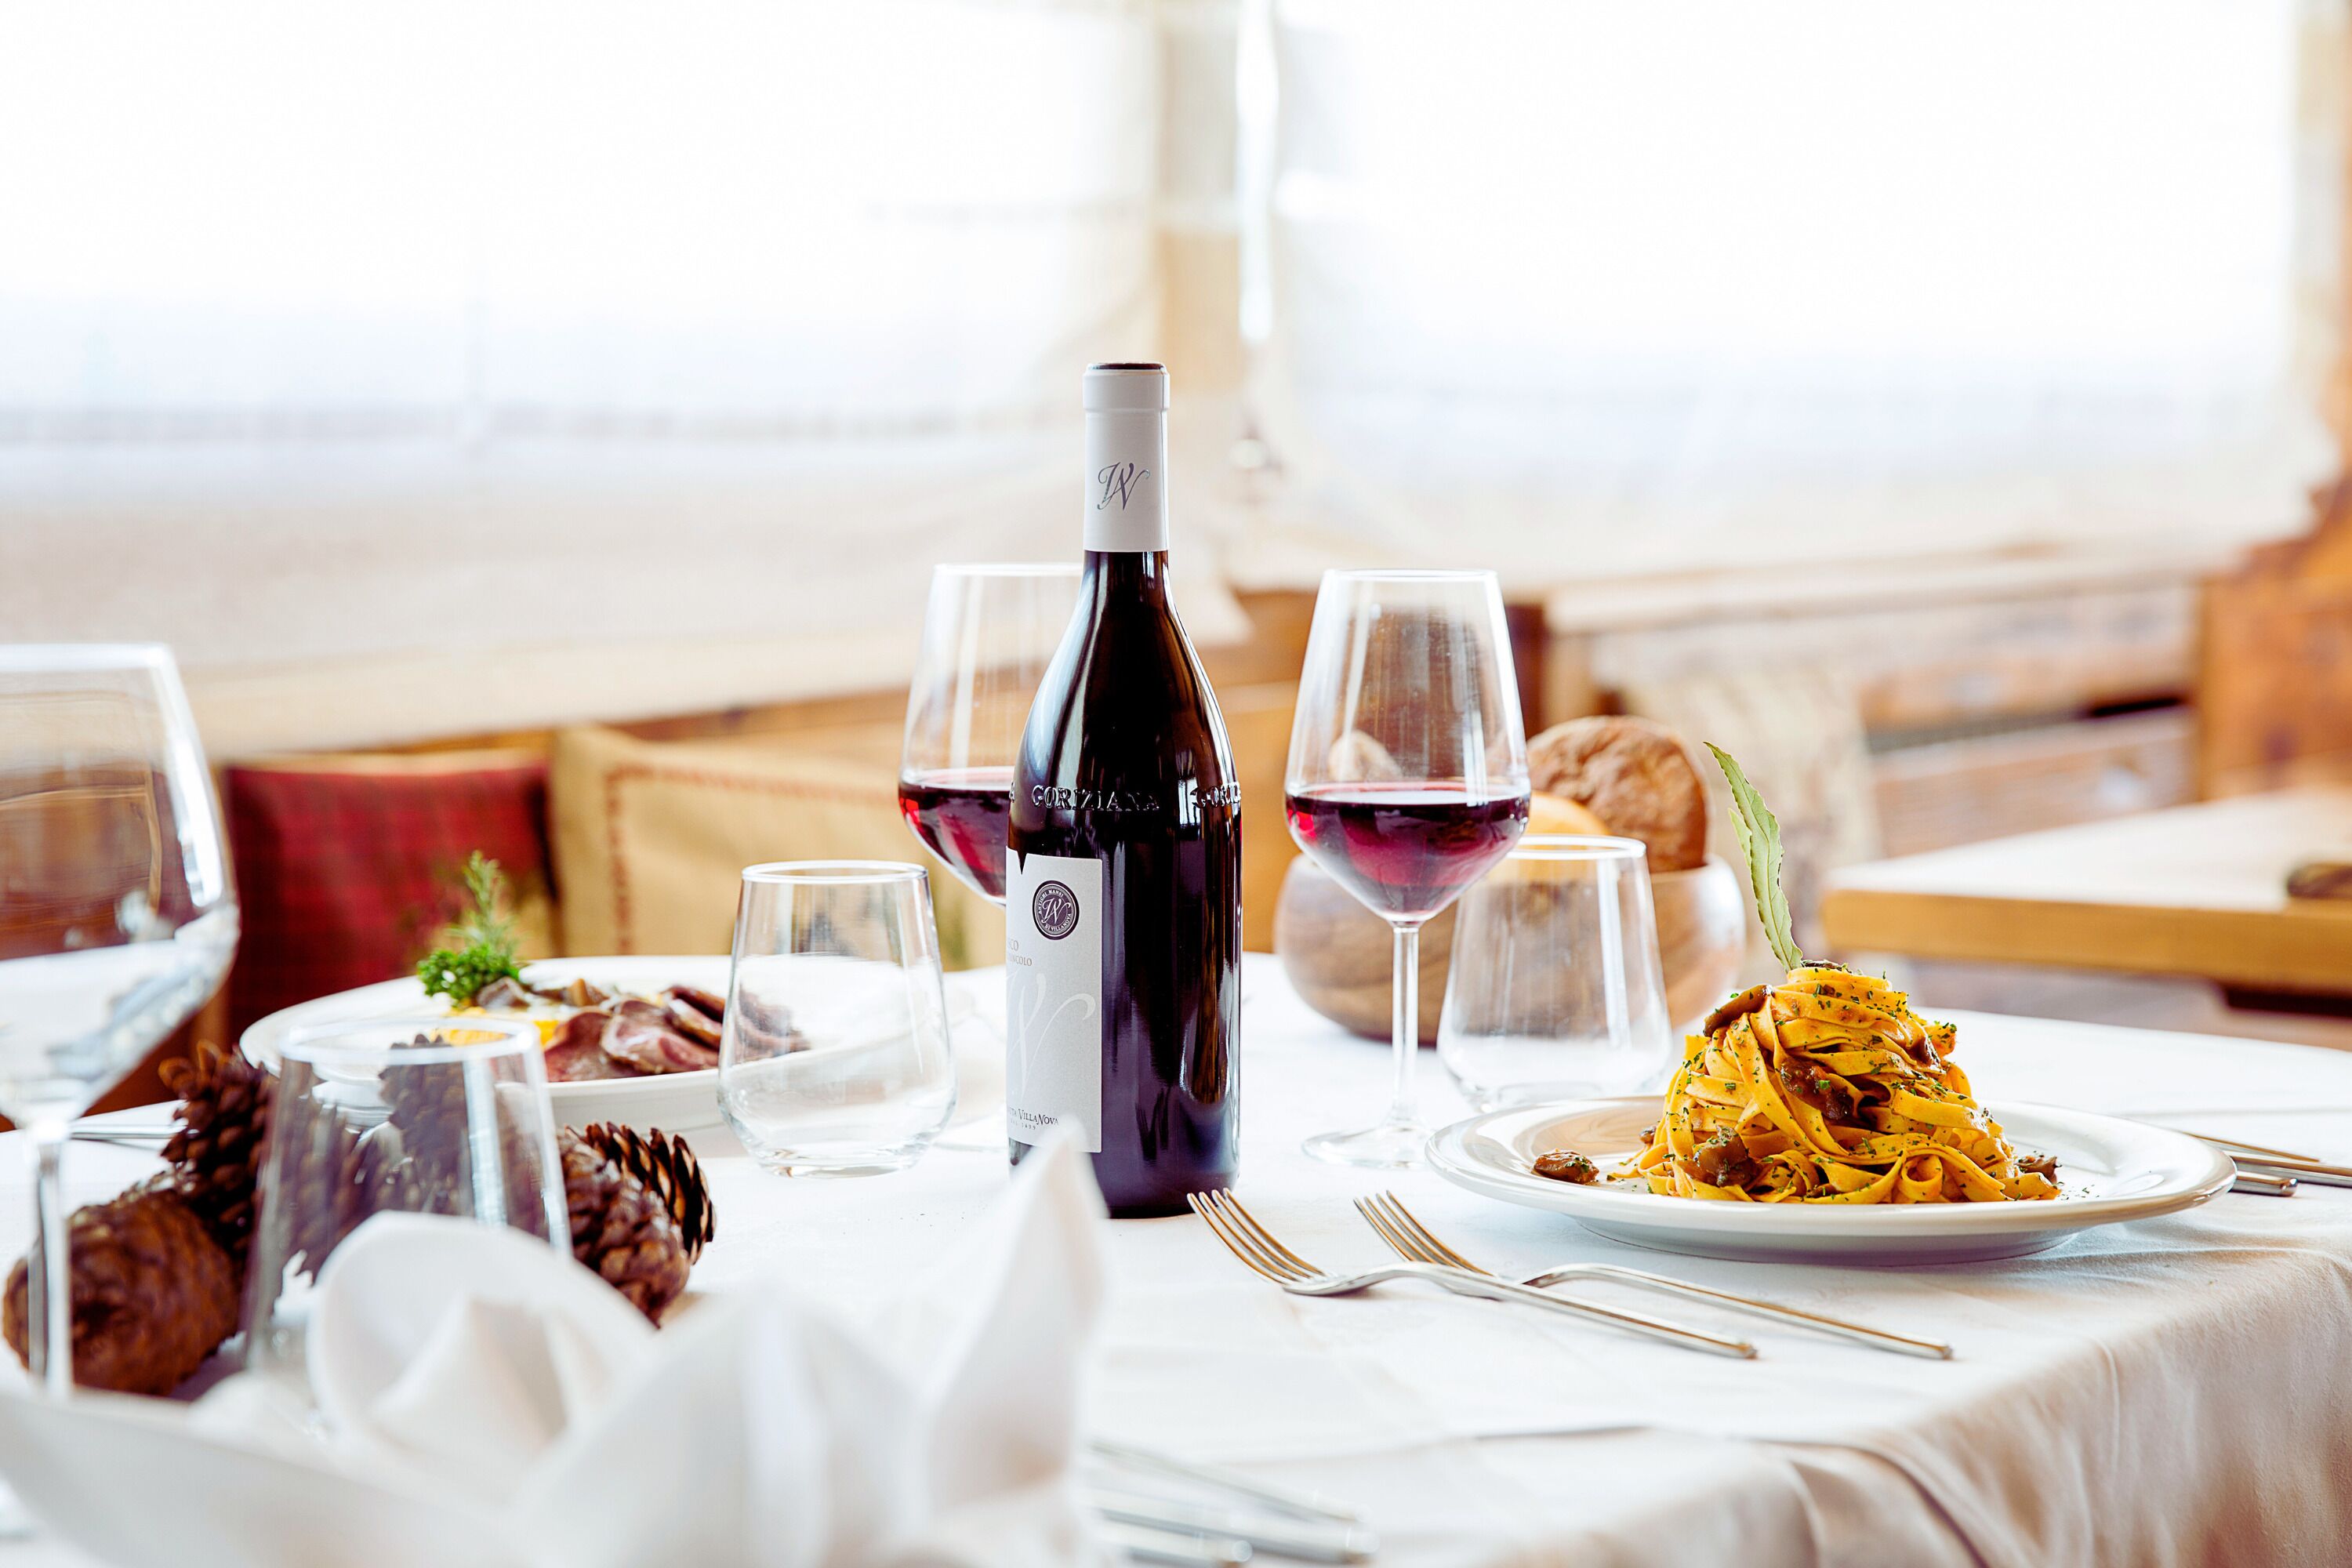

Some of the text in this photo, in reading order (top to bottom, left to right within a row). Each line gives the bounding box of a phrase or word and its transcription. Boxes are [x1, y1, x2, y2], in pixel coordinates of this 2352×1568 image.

[1031, 784, 1160, 811] GORIZIANA
[1037, 889, 1064, 915] ANTICHI MANSI
[1051, 913, 1072, 932] VILLANOVA
